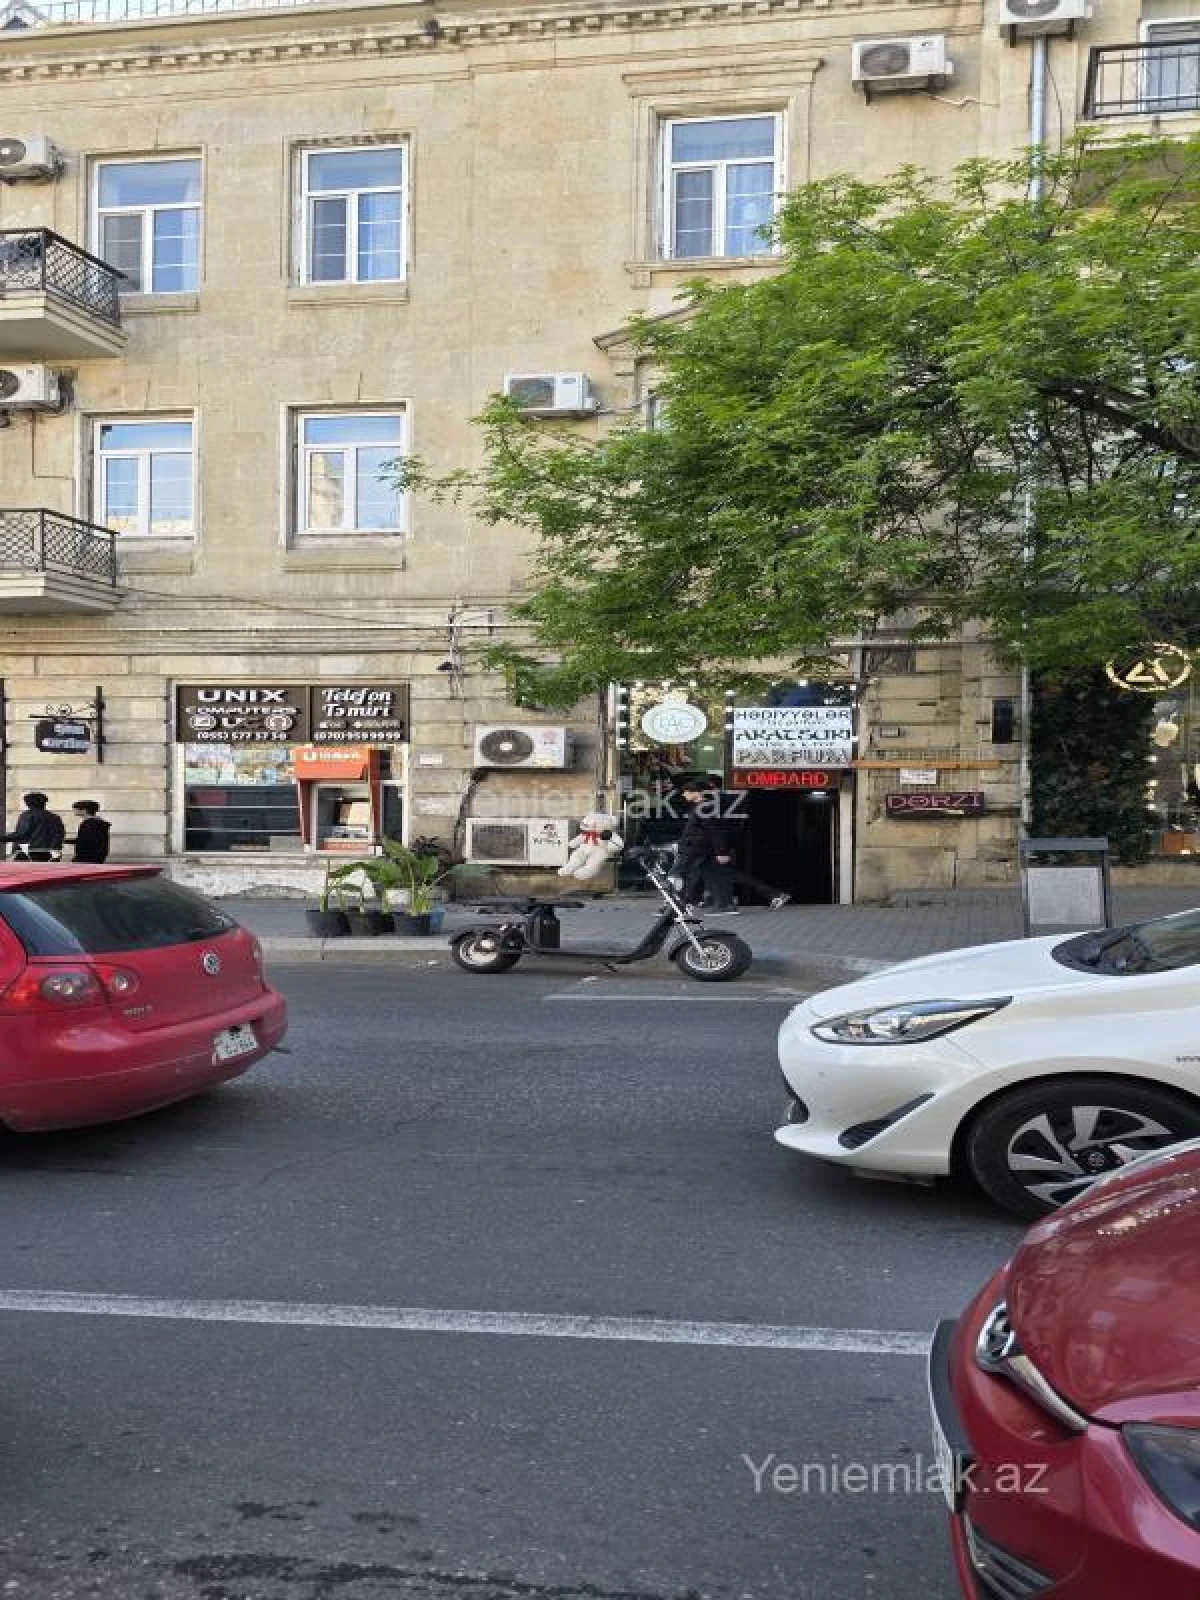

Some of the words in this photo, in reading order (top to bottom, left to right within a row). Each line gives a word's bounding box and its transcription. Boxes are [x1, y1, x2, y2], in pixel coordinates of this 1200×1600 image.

[197, 689, 286, 702] UNIX
[321, 688, 391, 704] Telefon
[733, 771, 829, 785] LOMBARD
